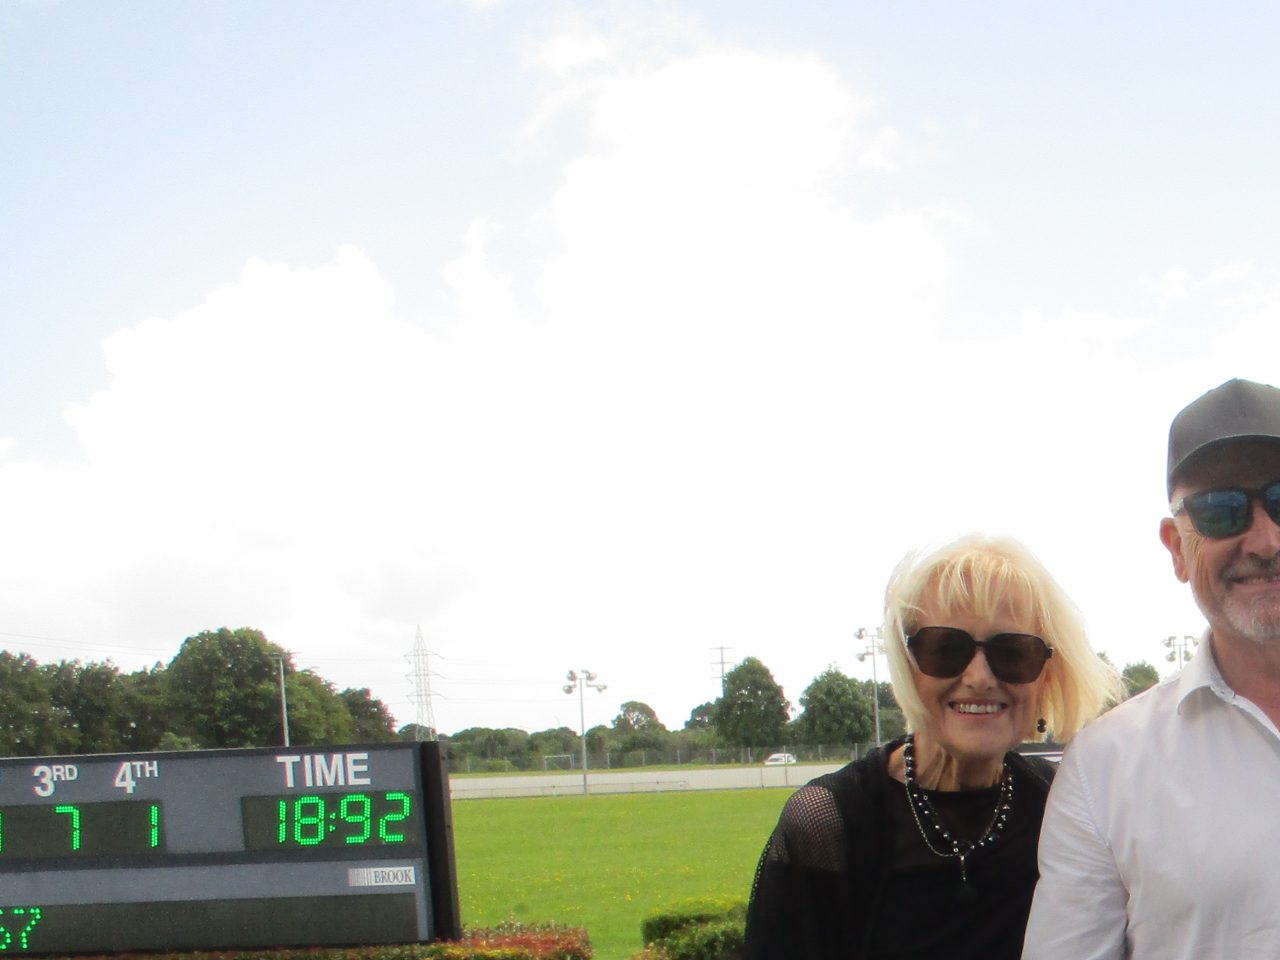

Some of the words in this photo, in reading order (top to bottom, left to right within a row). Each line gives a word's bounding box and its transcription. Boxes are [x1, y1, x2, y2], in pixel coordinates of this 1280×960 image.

[33, 764, 78, 797] 3RD
[113, 760, 160, 794] 4TH
[276, 753, 372, 789] TIME
[55, 805, 81, 851] 7
[150, 805, 160, 848] 1
[374, 869, 413, 884] BROOK
